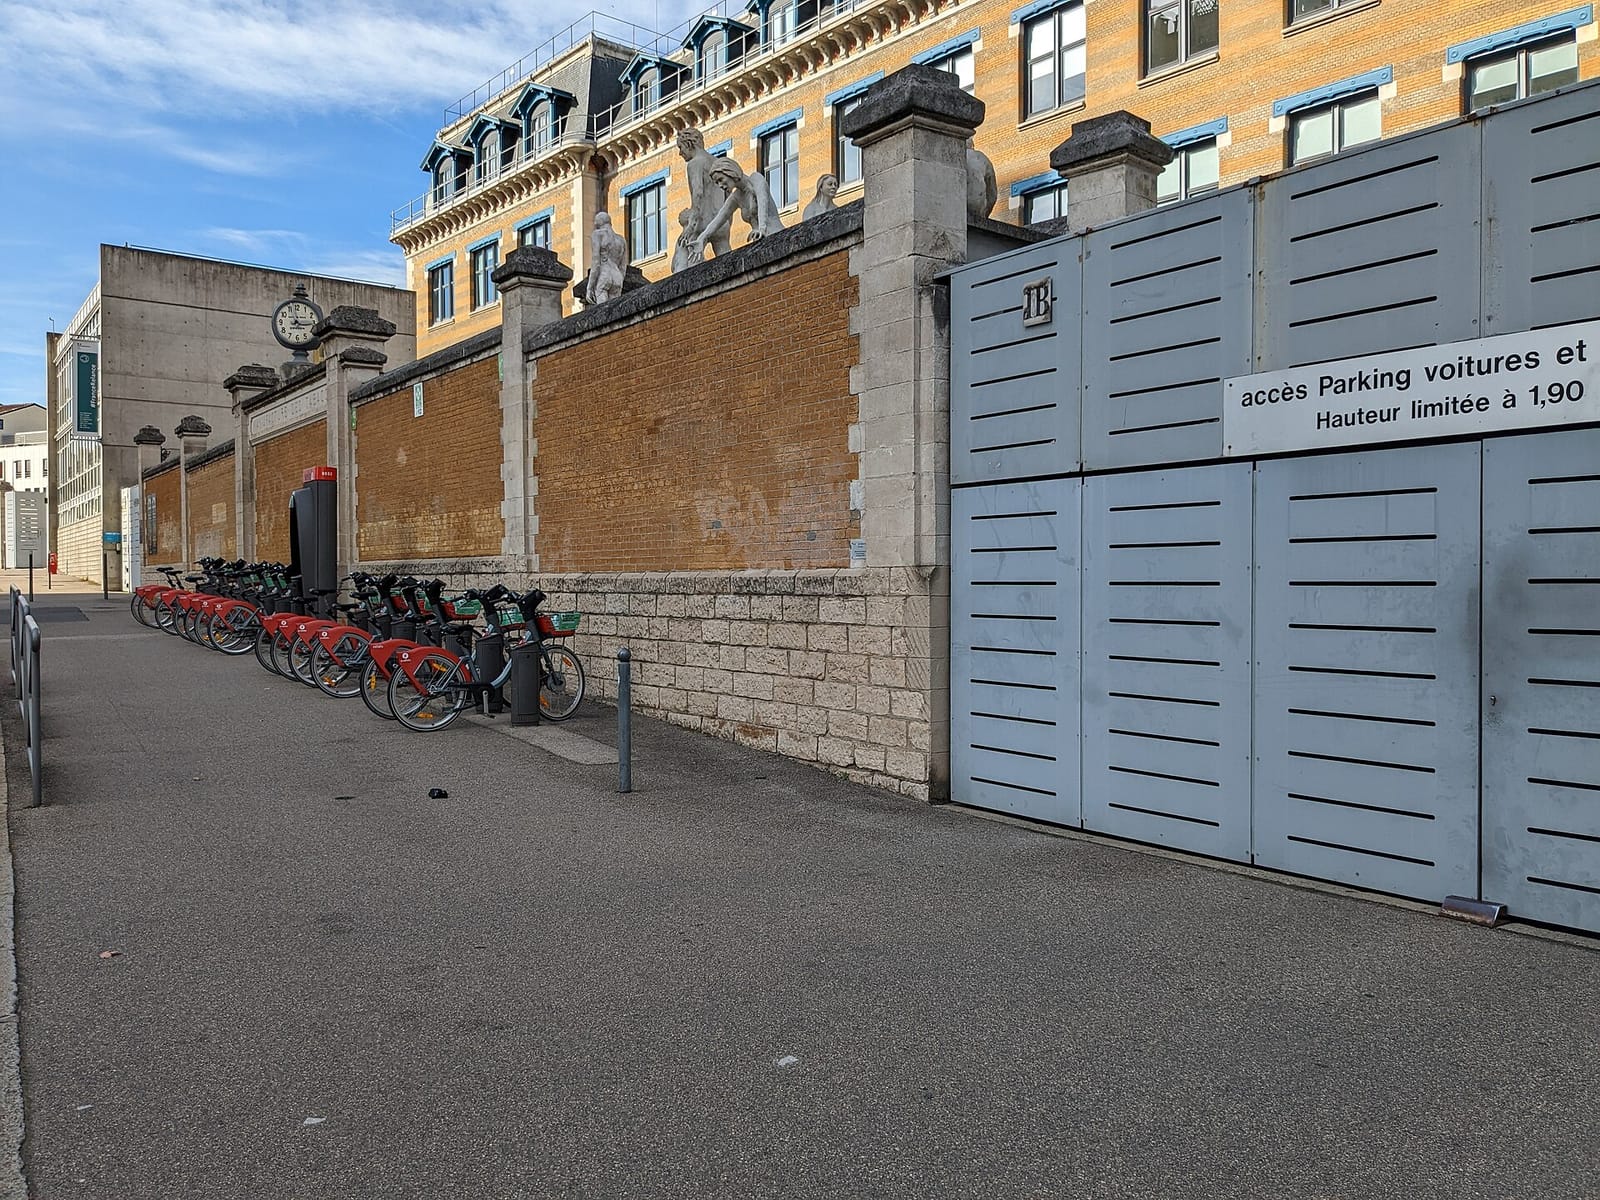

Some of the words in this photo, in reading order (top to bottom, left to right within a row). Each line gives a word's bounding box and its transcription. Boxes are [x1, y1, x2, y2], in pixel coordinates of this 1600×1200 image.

[1241, 381, 1308, 408] accès
[1319, 367, 1411, 397] Parking
[1425, 351, 1540, 382] voitures
[1557, 339, 1587, 365] et
[1316, 406, 1402, 430] Hauteur
[1411, 393, 1490, 420] limitée
[1502, 389, 1517, 409] à
[1529, 380, 1584, 410] 1,90
